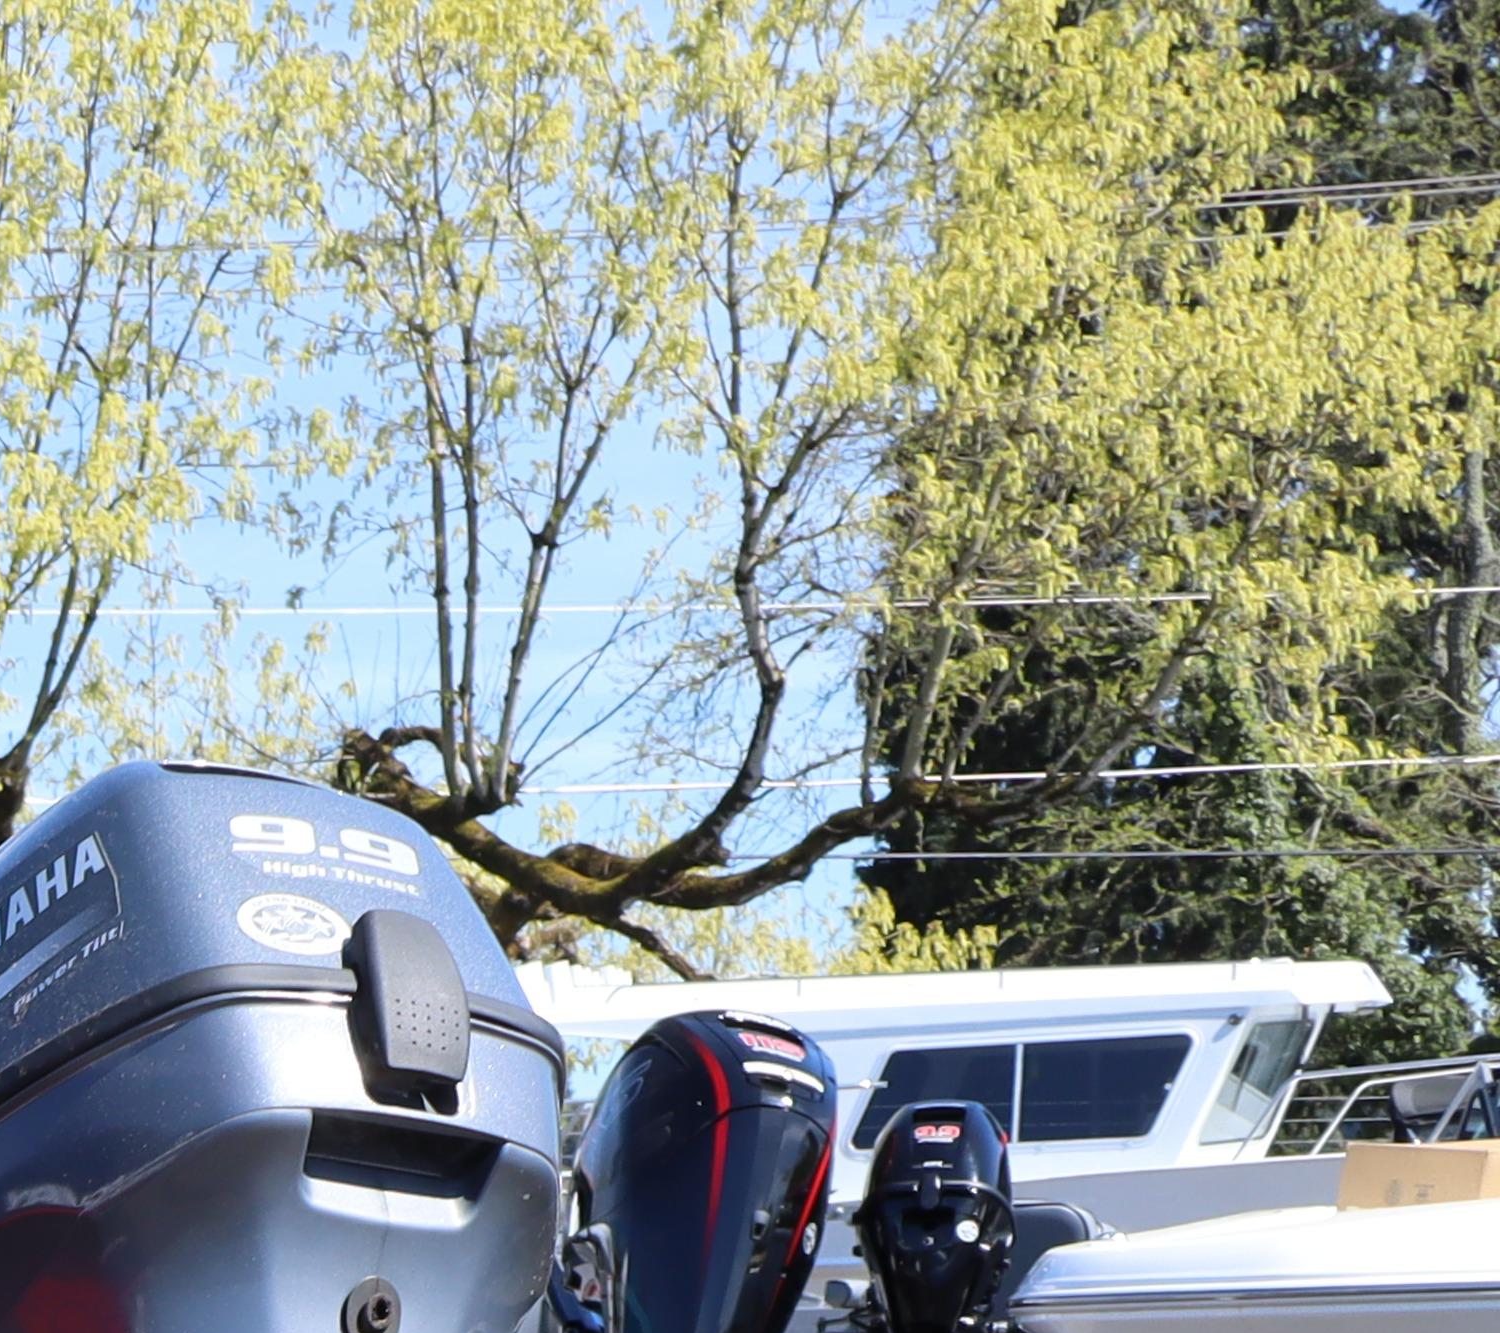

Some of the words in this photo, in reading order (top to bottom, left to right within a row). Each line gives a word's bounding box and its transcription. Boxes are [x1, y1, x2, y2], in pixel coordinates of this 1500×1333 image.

[229, 814, 420, 876] 9.9
[262, 861, 327, 879] High
[331, 867, 420, 896] Thrust
[13, 956, 77, 1016] Power
[81, 928, 119, 959] Tilt
